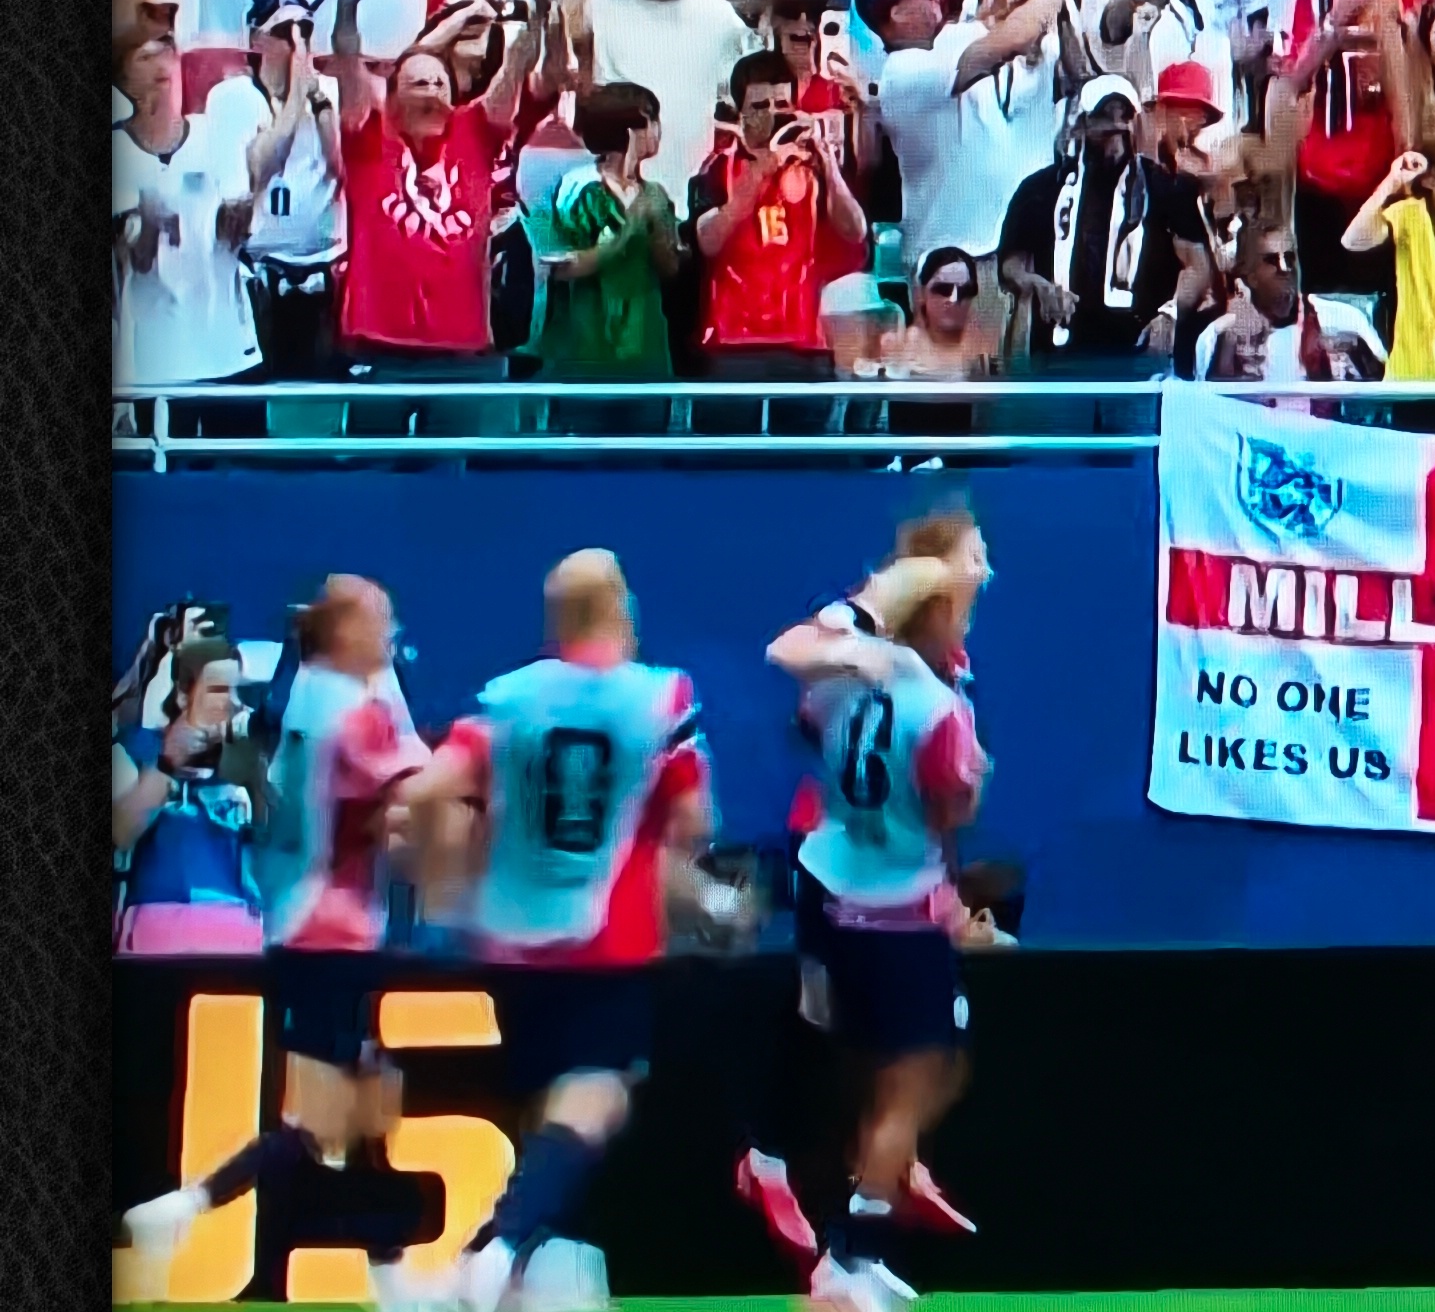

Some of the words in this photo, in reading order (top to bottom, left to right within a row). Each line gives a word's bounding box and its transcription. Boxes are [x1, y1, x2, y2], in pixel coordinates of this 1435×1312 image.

[1197, 668, 1258, 709] NO
[1276, 680, 1371, 723] ONE
[1178, 729, 1309, 775] LIKES
